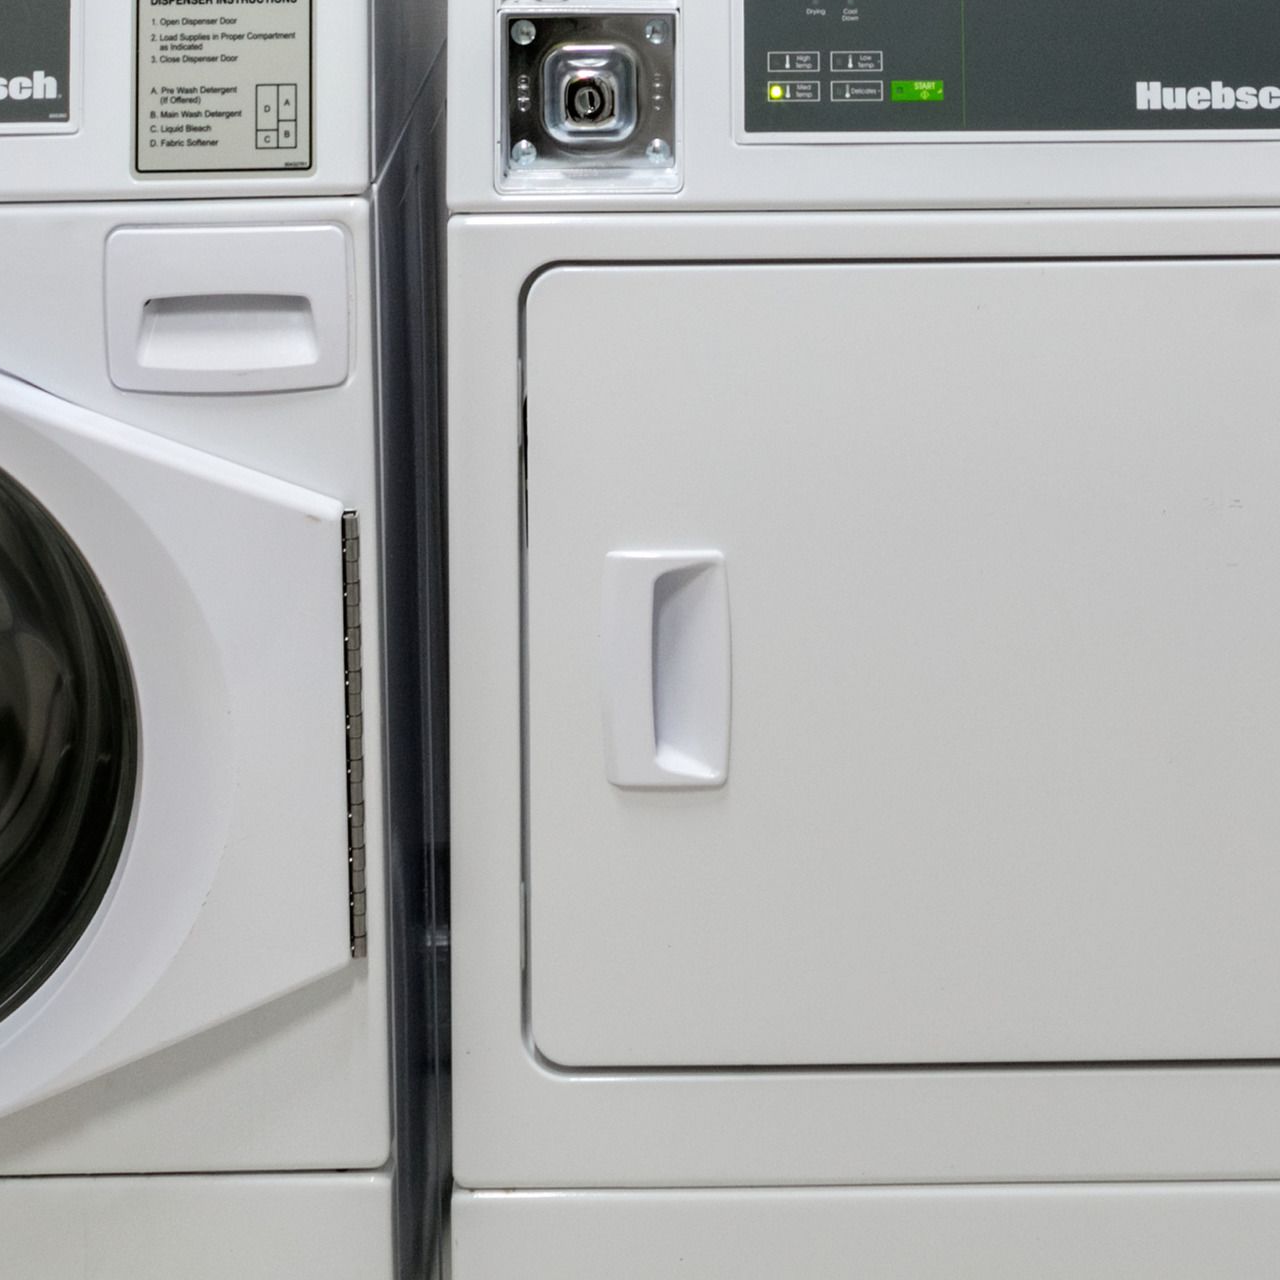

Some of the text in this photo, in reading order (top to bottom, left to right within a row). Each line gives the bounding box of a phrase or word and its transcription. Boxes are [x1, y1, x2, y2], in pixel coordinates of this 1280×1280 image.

[160, 18, 179, 26] Open
[182, 18, 217, 26] Dispenser
[180, 33, 210, 42] Supplies
[221, 33, 245, 41] Proper
[247, 32, 295, 41] Compartment
[182, 55, 218, 63] Dispenser
[200, 86, 237, 95] Detergent
[914, 82, 936, 90] START
[160, 96, 201, 105] (If Offered)
[204, 110, 241, 119] Detergent
